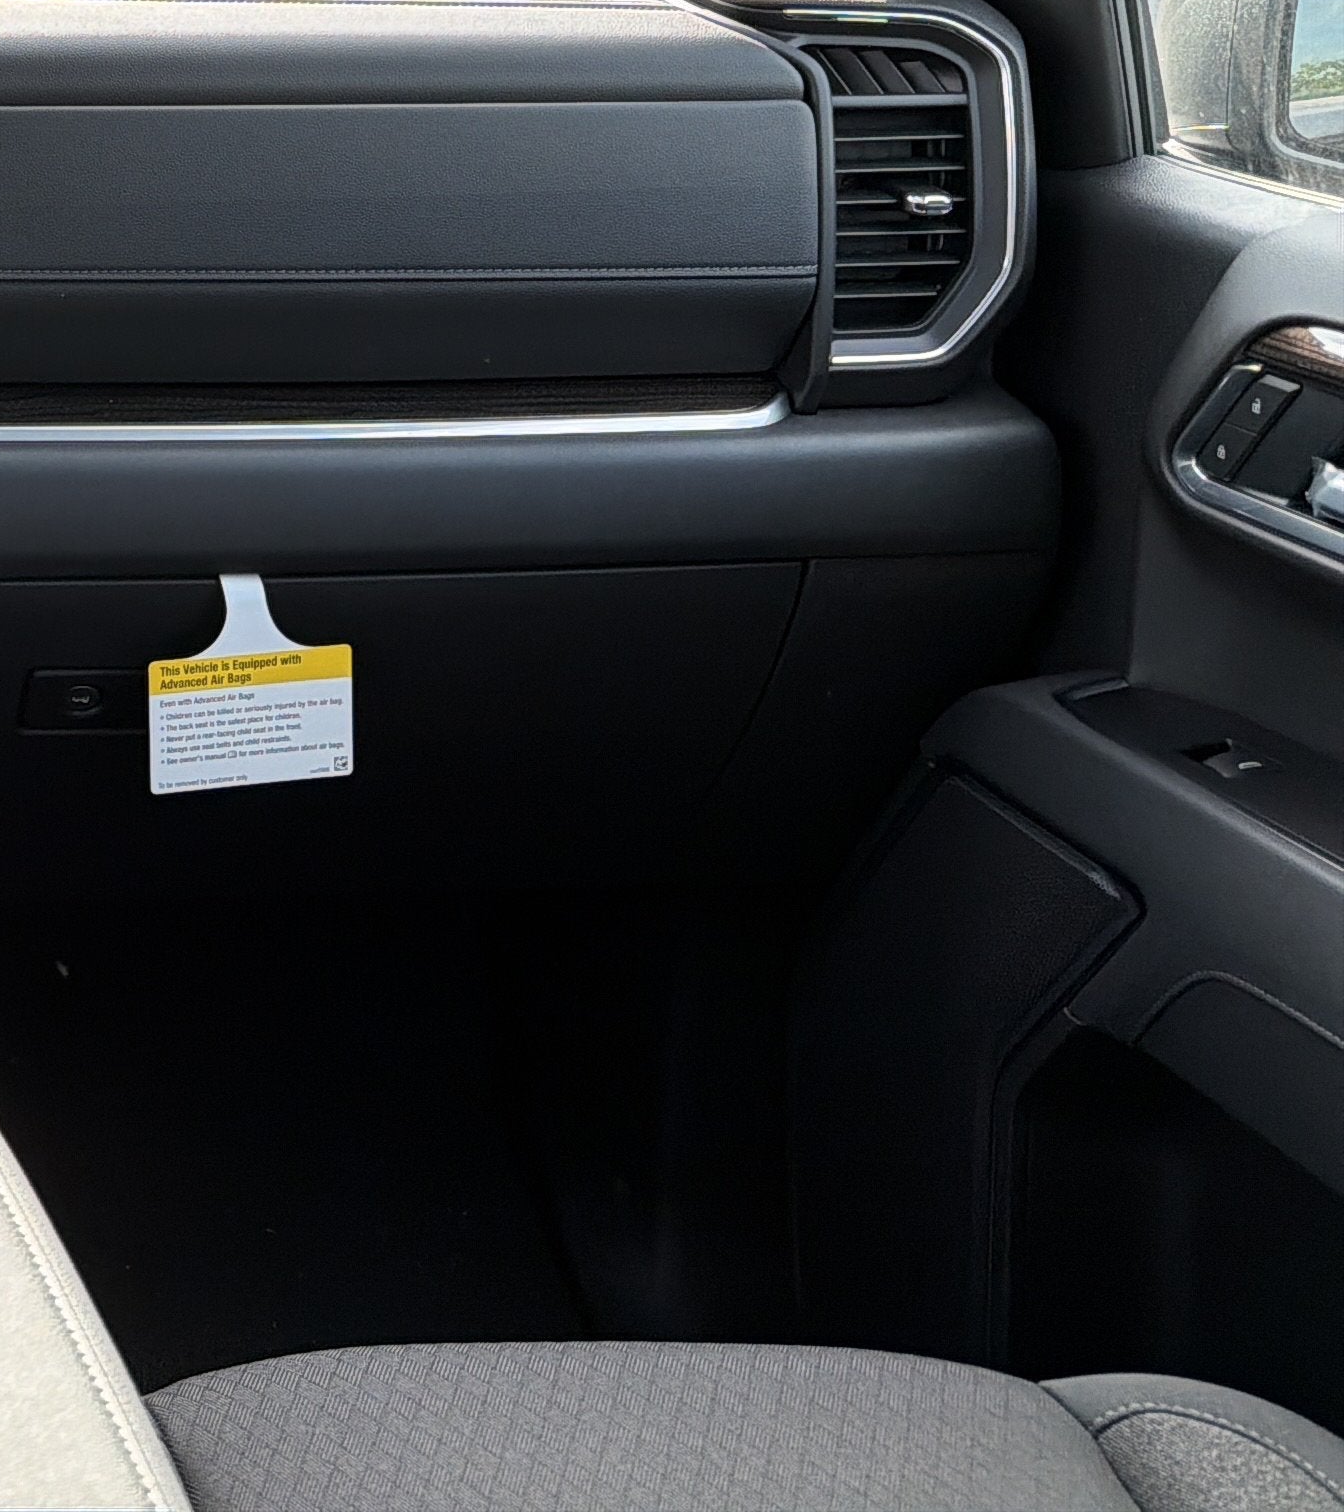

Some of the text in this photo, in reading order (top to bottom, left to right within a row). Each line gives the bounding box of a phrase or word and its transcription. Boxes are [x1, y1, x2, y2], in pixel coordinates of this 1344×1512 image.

[160, 654, 302, 678] This Vehicle is Equipped with
[160, 672, 252, 690] Advanced Air Bags
[160, 692, 255, 708] Even with Advanced Air Bags
[166, 712, 193, 720] Children
[216, 708, 234, 716] killed
[244, 704, 272, 712] seriously
[274, 702, 297, 710] injured
[298, 701, 306, 709] by
[319, 698, 328, 706] air
[330, 698, 343, 706] bag.
